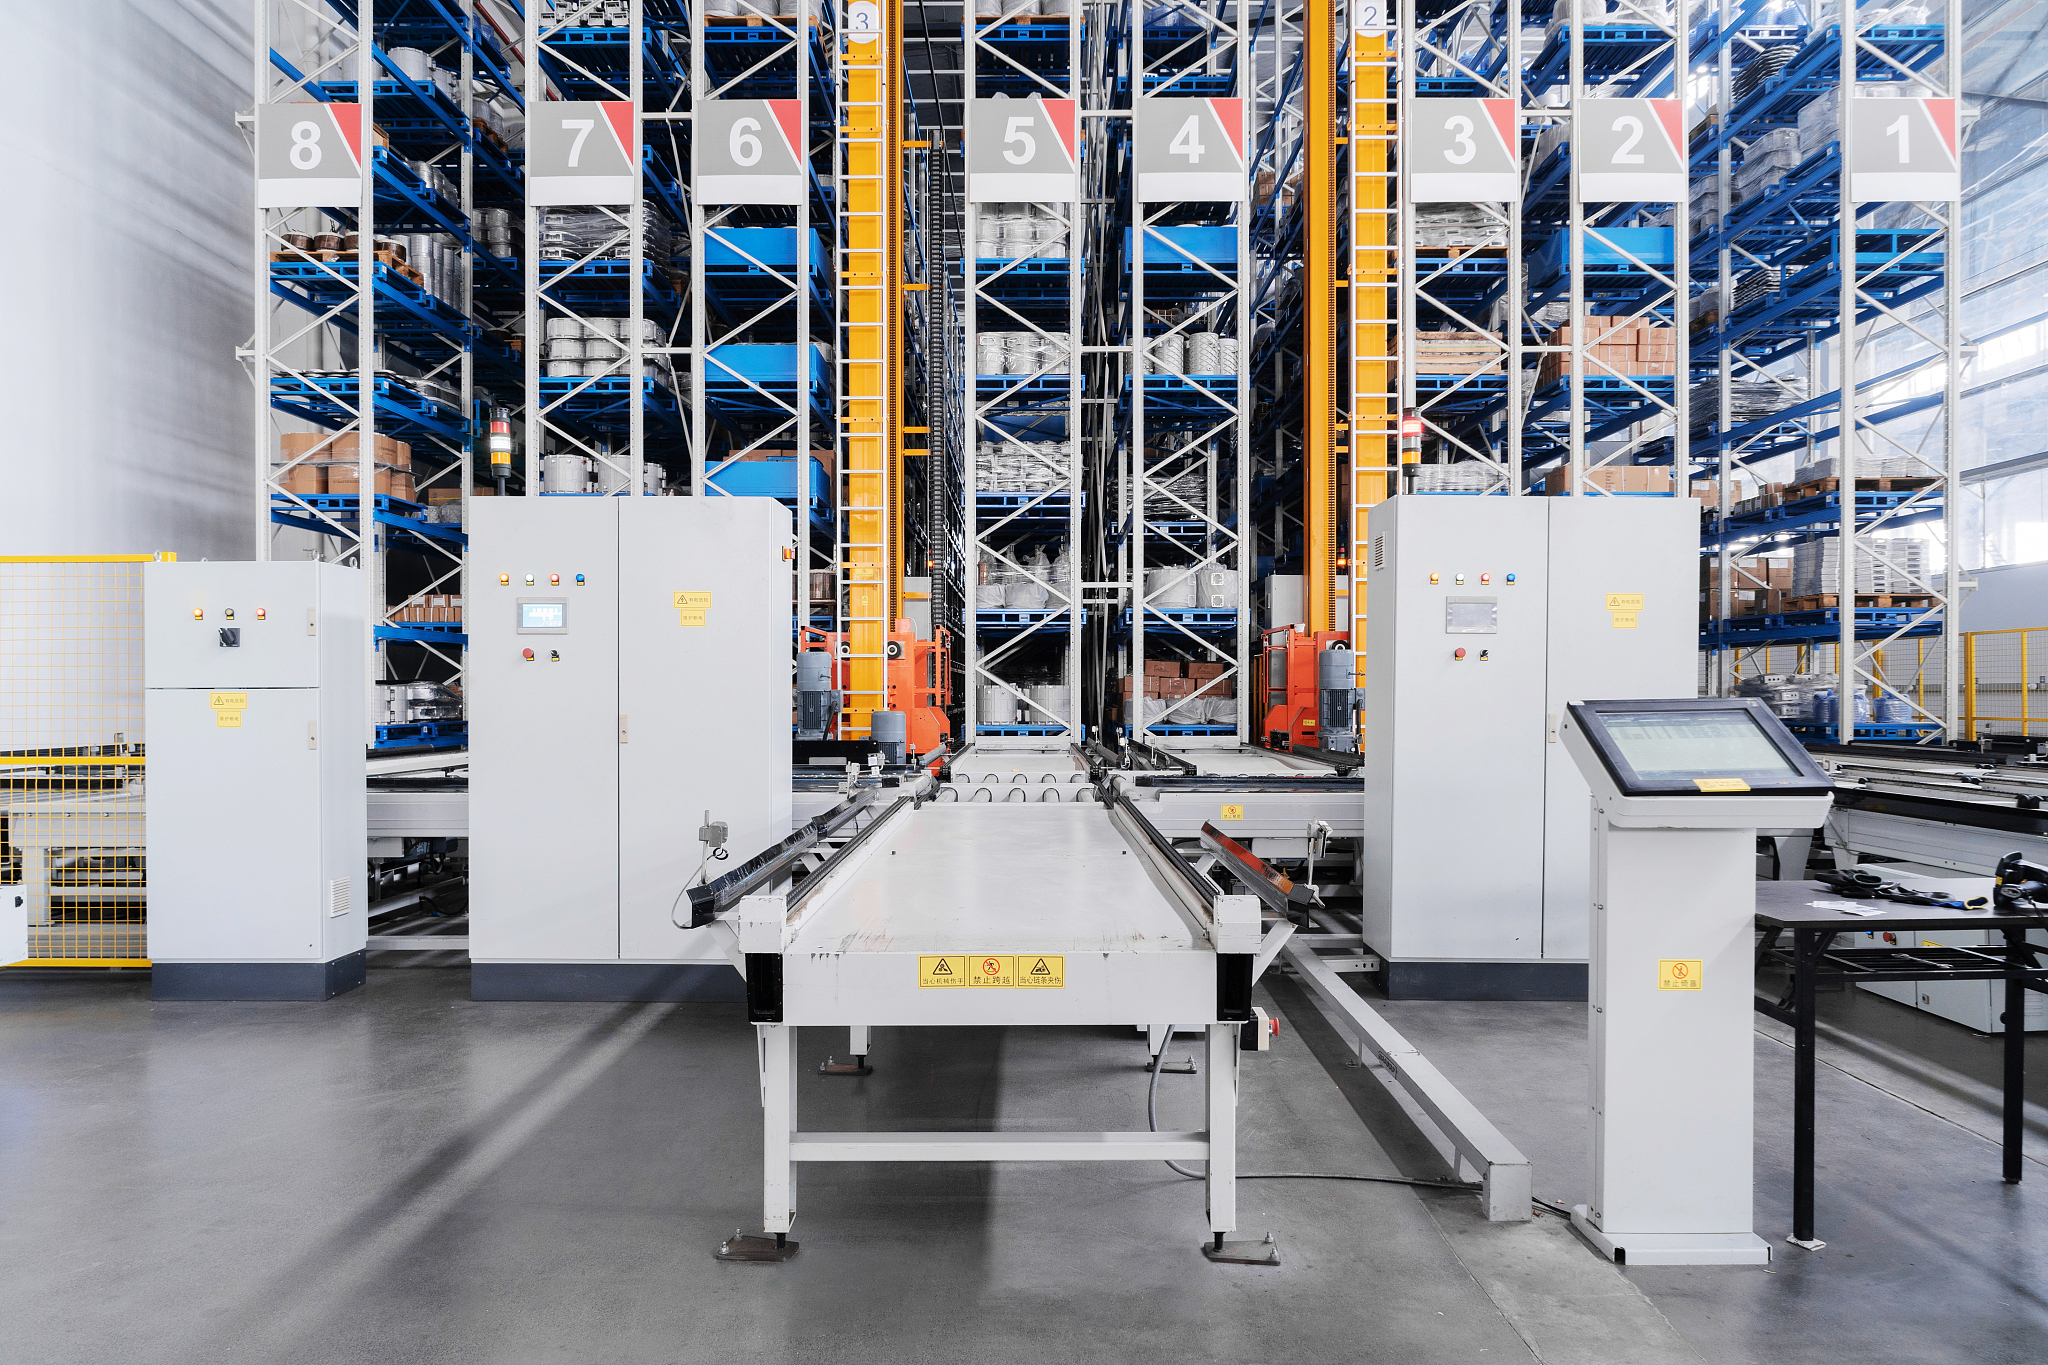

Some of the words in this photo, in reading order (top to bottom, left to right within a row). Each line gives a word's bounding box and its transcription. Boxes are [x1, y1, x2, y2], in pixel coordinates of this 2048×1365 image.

[856, 12, 869, 29] 3
[1364, 6, 1377, 26] 2
[289, 120, 322, 170] 8
[561, 119, 595, 168] 7
[729, 116, 763, 167] 6
[1002, 116, 1036, 165] 5
[1169, 114, 1205, 164] 4
[1443, 115, 1477, 165] 3
[1611, 115, 1645, 164] 2
[1886, 115, 1910, 164] 1
[922, 977, 964, 985] 当心机械伤手
[972, 976, 1011, 985] 禁止跨越
[1019, 976, 1062, 985] 当心链条夹伤
